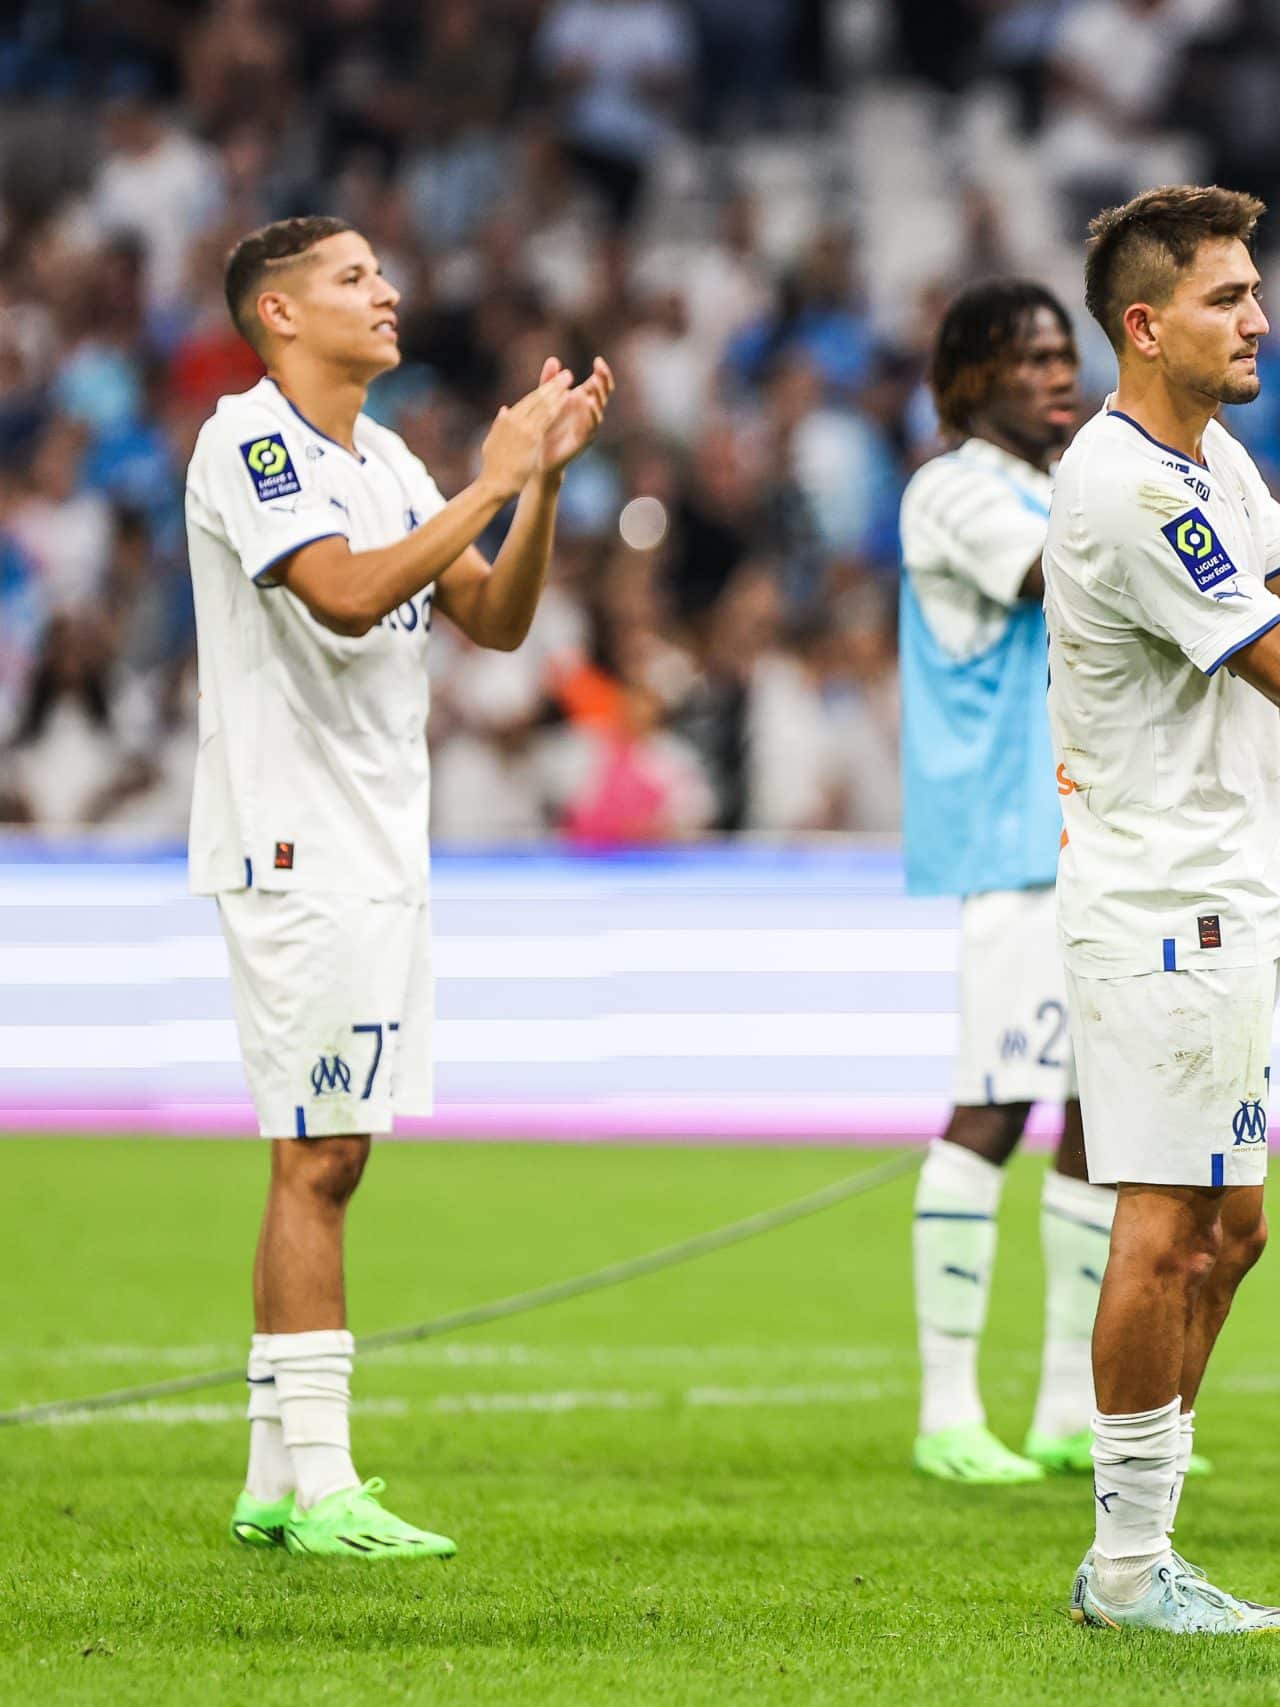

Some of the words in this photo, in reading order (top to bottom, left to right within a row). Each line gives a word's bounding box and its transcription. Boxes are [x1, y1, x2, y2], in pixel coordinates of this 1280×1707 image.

[1194, 555, 1219, 575] LIGUE
[1198, 571, 1216, 585] Uber
[1213, 562, 1232, 576] Eats
